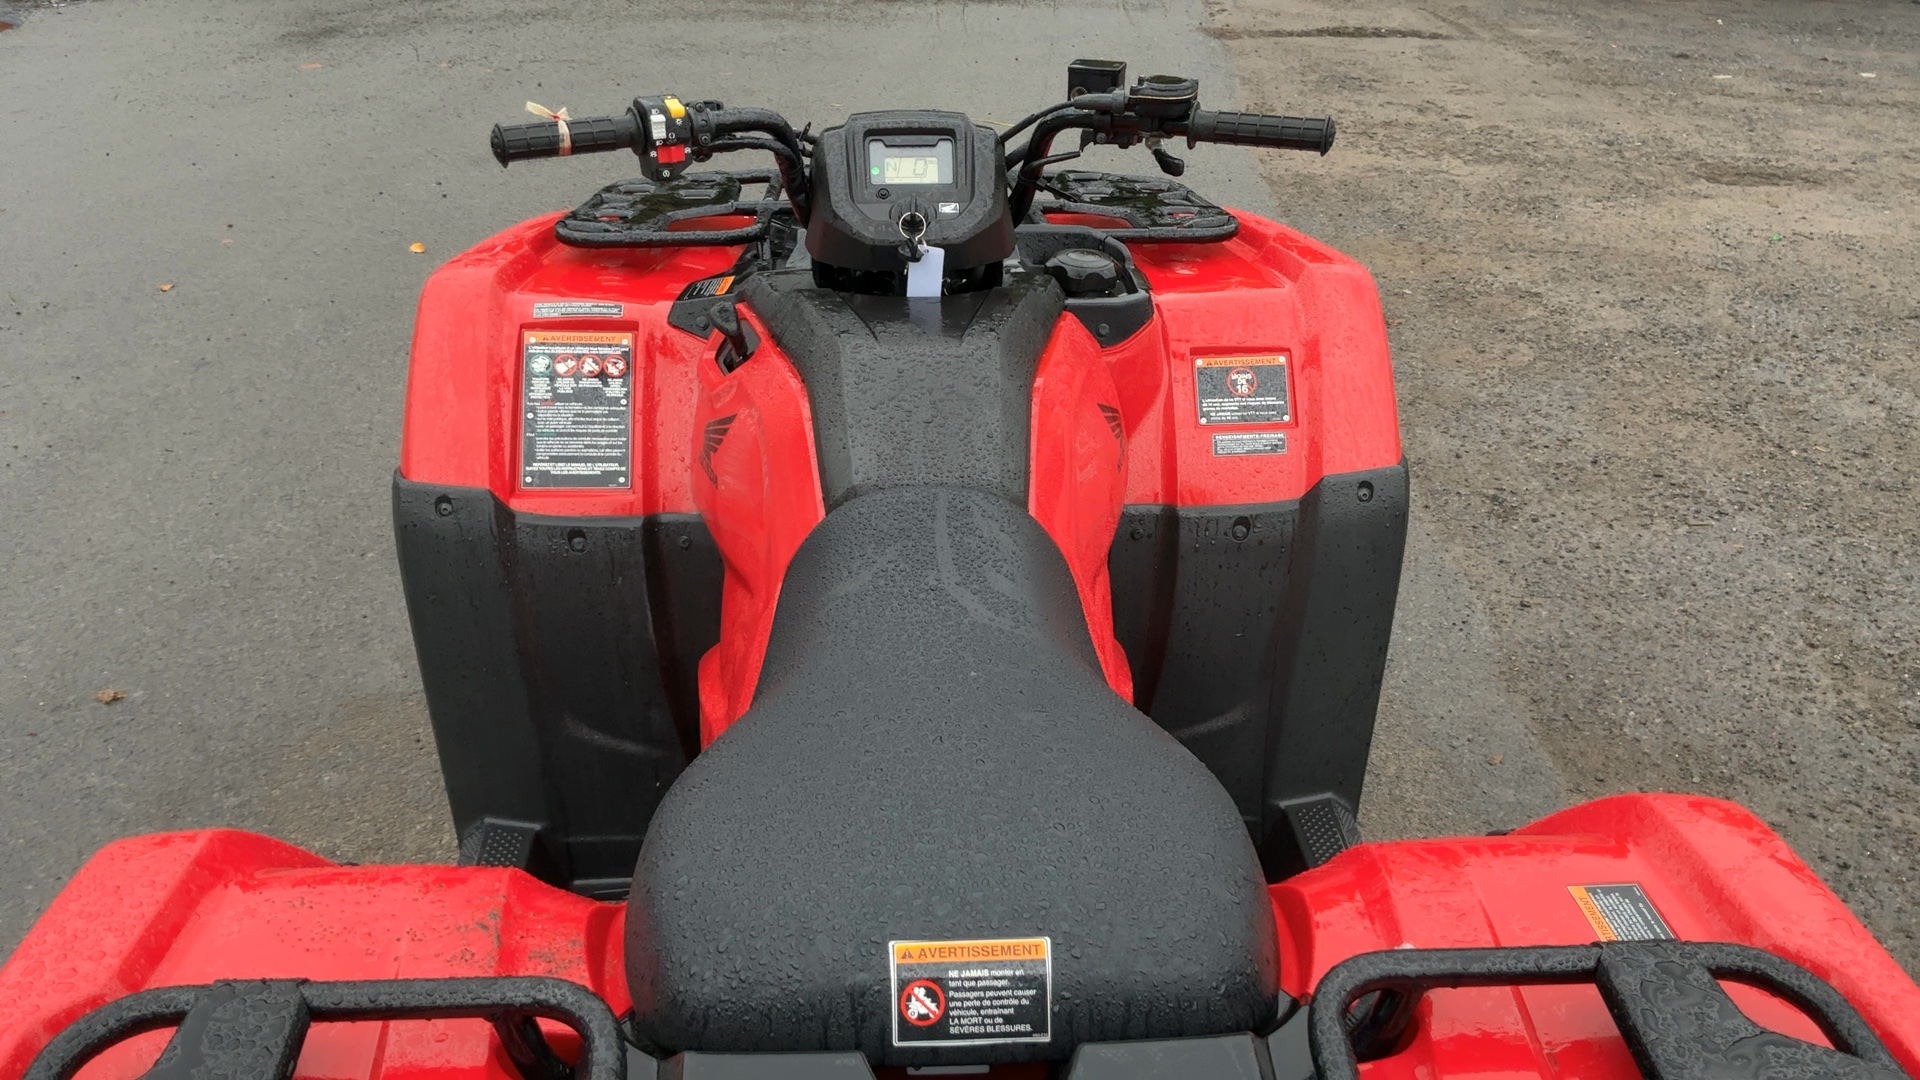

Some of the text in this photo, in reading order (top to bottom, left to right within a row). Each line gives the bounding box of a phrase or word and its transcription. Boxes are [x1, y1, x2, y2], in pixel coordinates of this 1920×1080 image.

[886, 160, 898, 172] N
[1214, 358, 1276, 366] AVERTISSEMENT
[1236, 385, 1248, 393] 16
[918, 944, 1040, 959] AVERTISSEMENT
[960, 969, 989, 977] JAMAIS
[977, 979, 1010, 988] passager.
[949, 991, 984, 999] Passagers
[986, 990, 1012, 998] peuvent
[950, 1024, 1033, 1034] SÉVÈRES BLESSURES.
